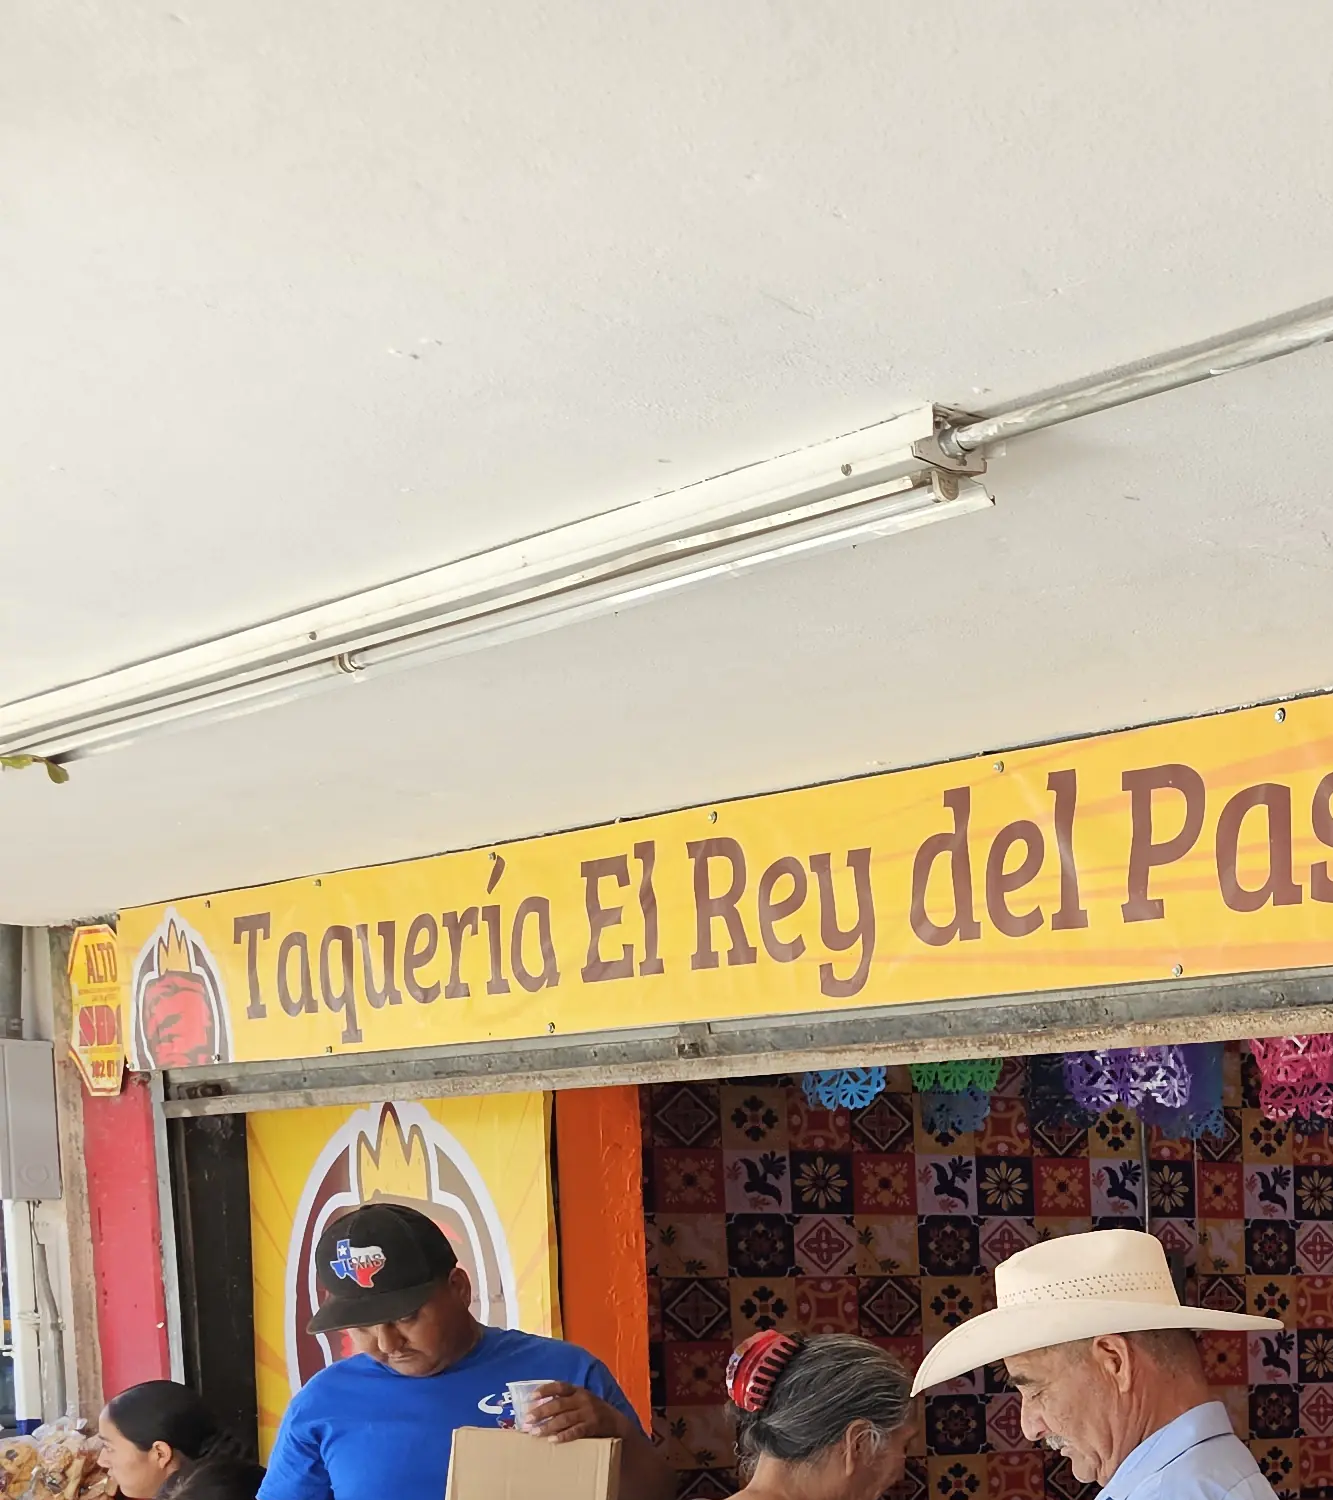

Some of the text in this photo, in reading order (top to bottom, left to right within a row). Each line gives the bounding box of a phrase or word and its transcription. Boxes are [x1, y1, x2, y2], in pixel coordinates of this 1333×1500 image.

[232, 855, 562, 1043] Taquería
[579, 839, 665, 983] El
[685, 836, 877, 998] Rey
[908, 767, 1089, 947] del
[84, 941, 118, 985] ALTO
[341, 1253, 383, 1273] TEXAS
